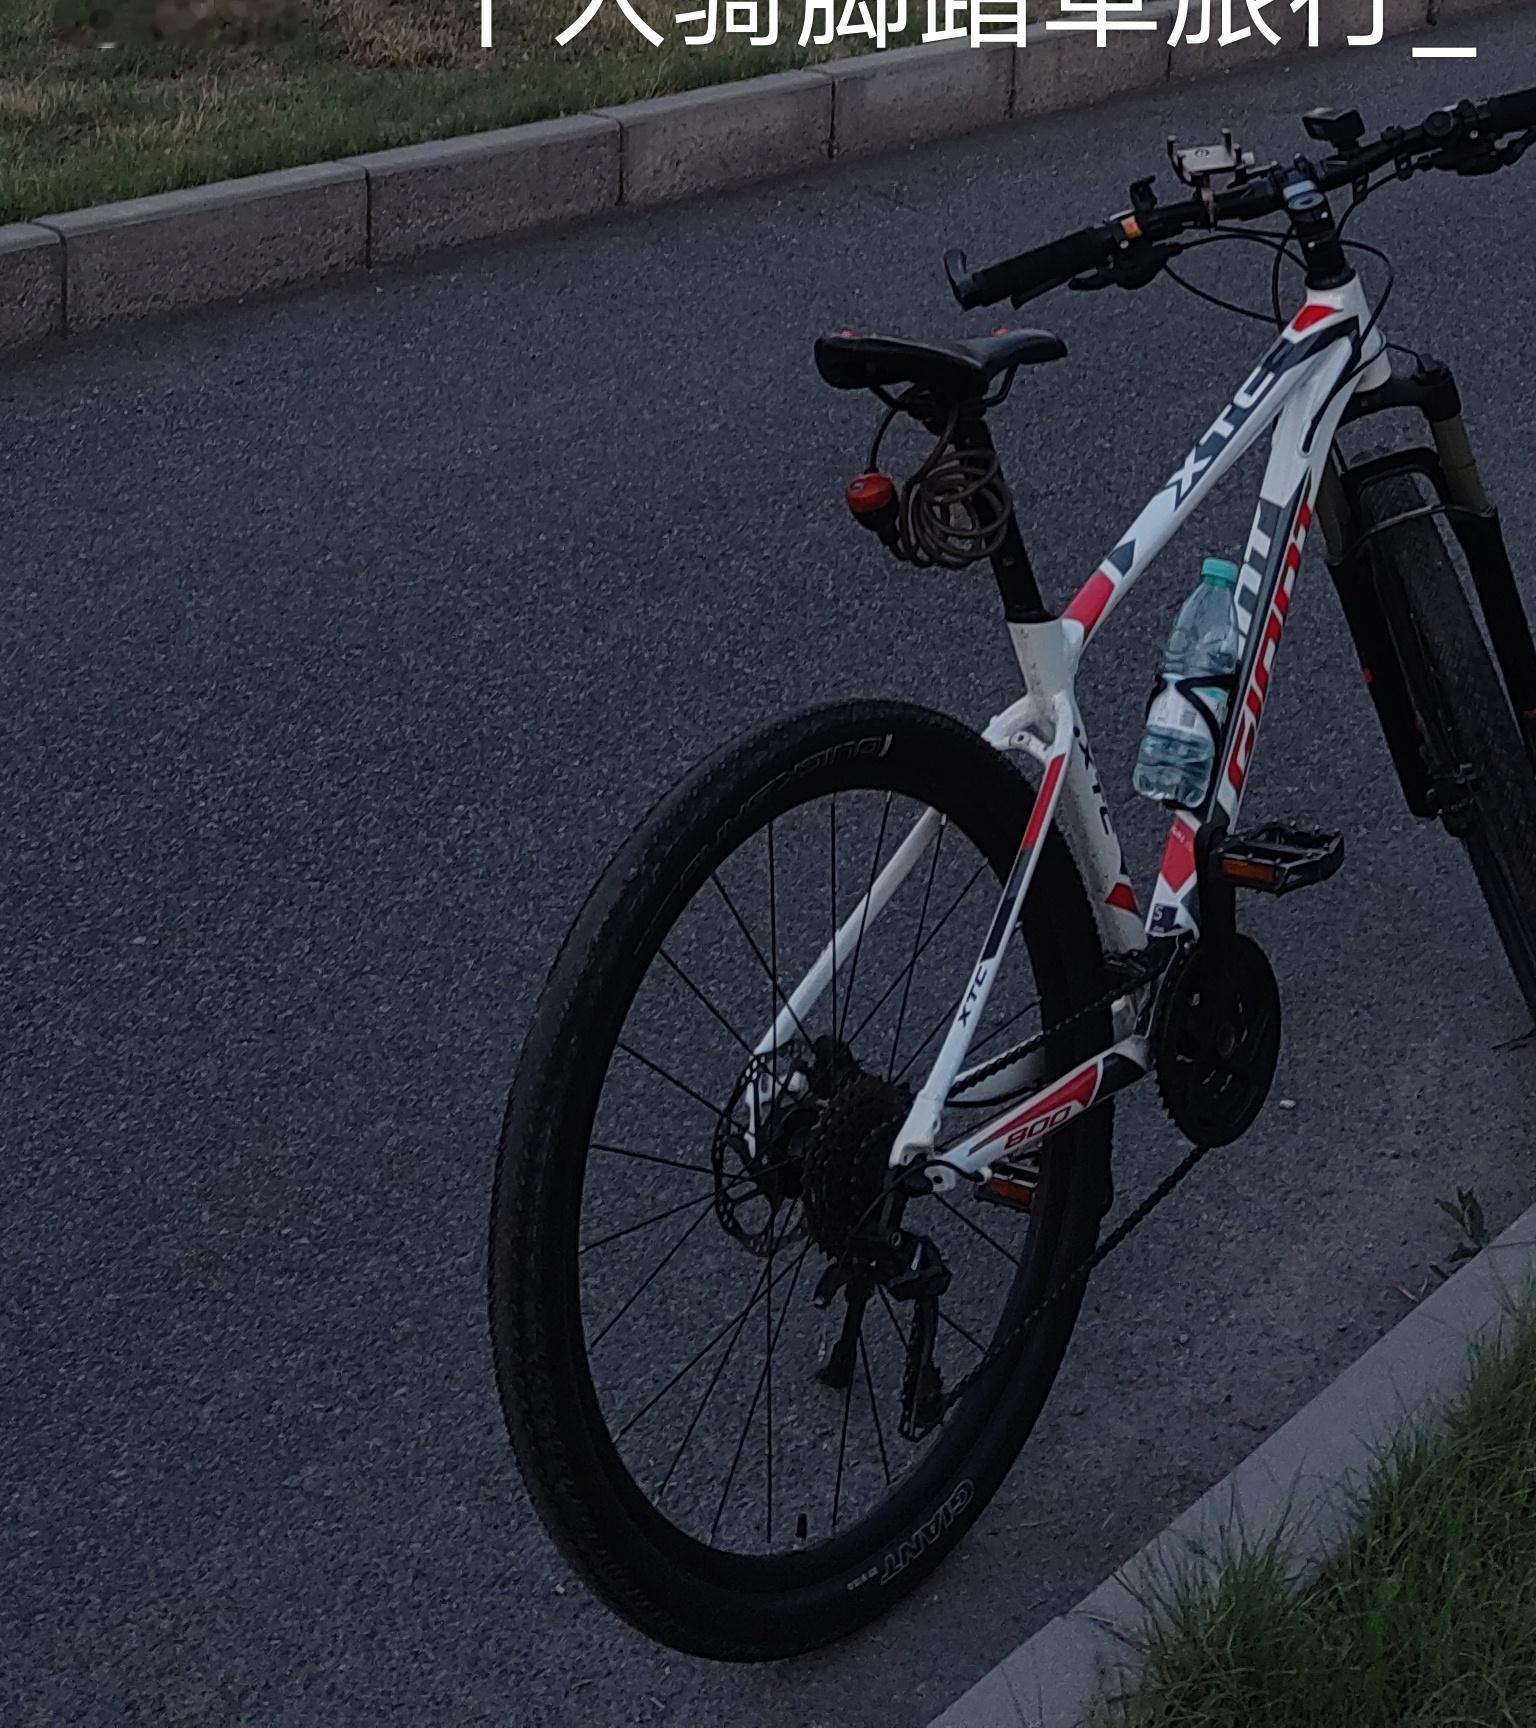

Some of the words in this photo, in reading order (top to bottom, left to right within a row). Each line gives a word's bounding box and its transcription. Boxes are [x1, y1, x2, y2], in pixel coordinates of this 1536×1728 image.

[958, 965, 988, 1028] XTC
[1004, 1105, 1072, 1149] 800
[879, 1478, 976, 1586] GIANT
